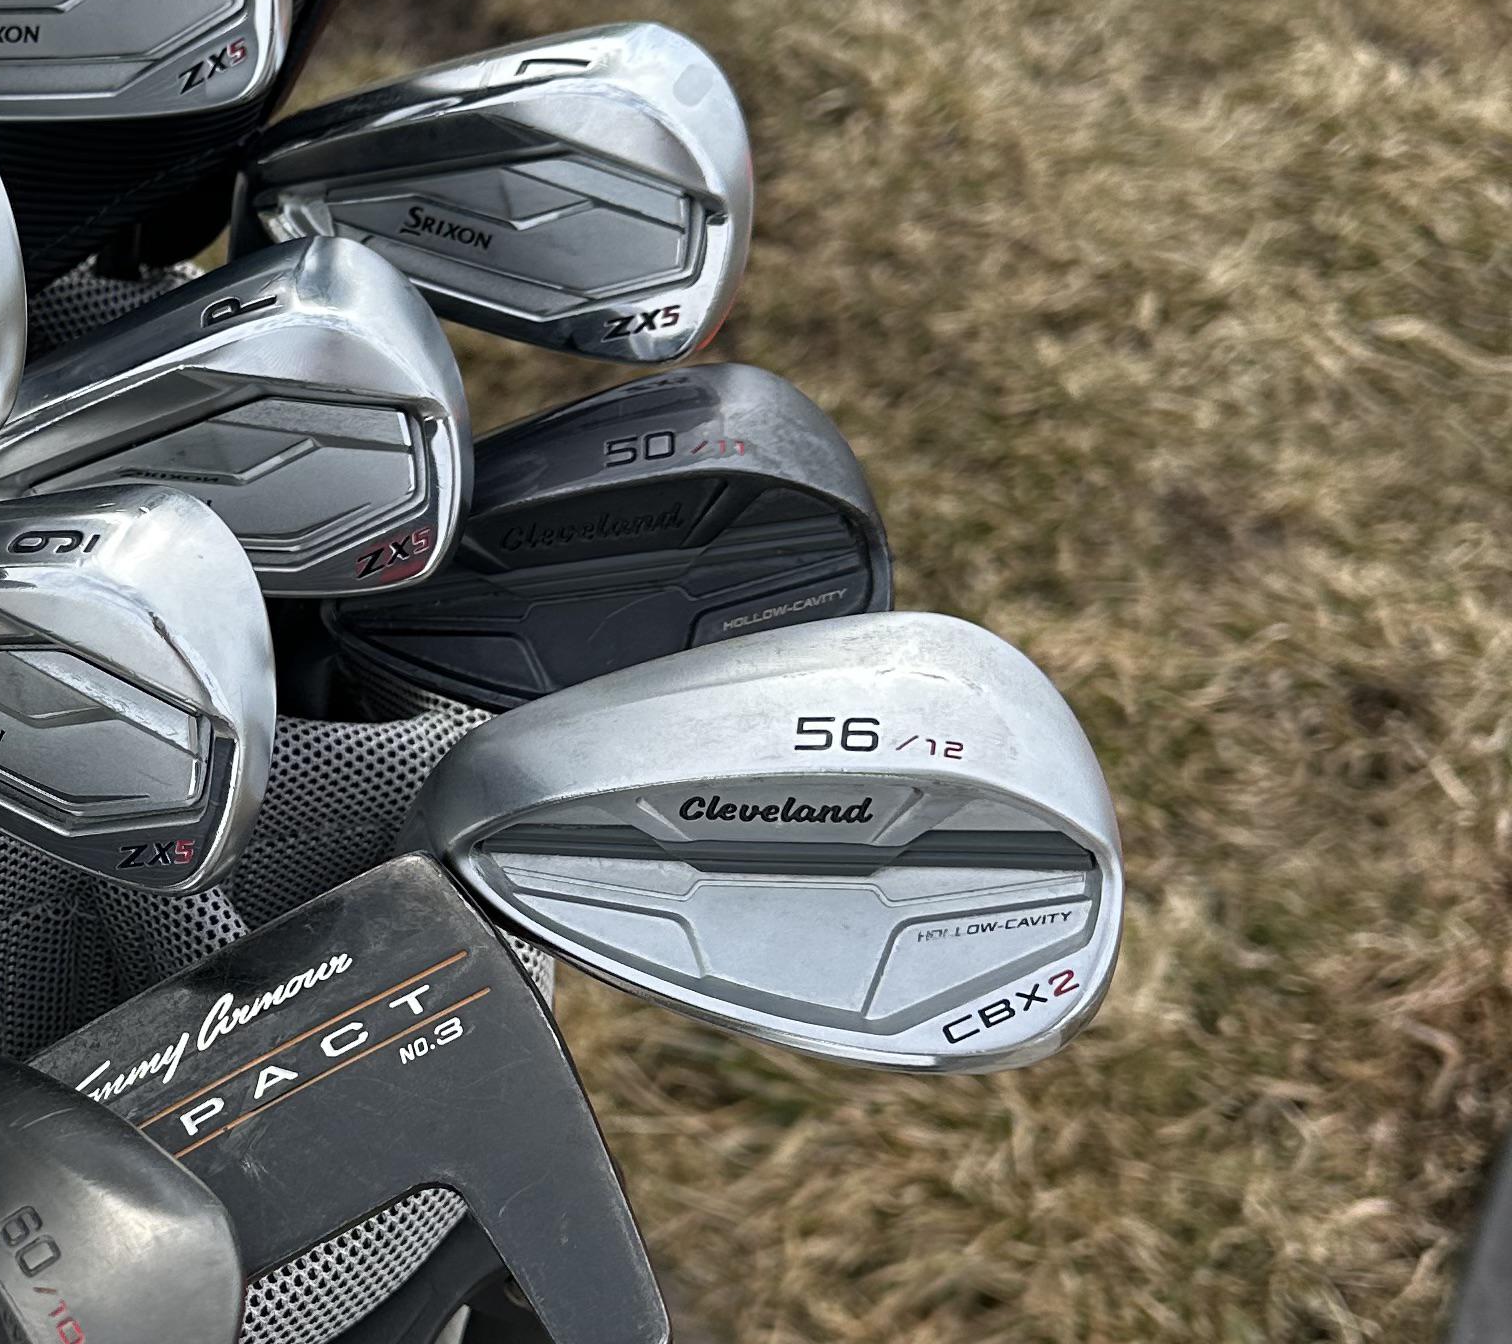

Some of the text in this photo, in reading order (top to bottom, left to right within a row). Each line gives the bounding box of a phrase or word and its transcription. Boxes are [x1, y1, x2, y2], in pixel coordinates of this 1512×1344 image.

[178, 39, 248, 96] ZX5
[399, 205, 494, 251] SRIXON
[600, 304, 682, 343] ZX5
[500, 500, 687, 552] Cleveland
[355, 526, 432, 582] ZX5
[722, 588, 847, 632] HOLLOW-CAVITY
[678, 795, 874, 826] Cleveland
[116, 839, 196, 871] ZX5
[942, 968, 1080, 1045] CBX2
[179, 984, 431, 1137] PACT
